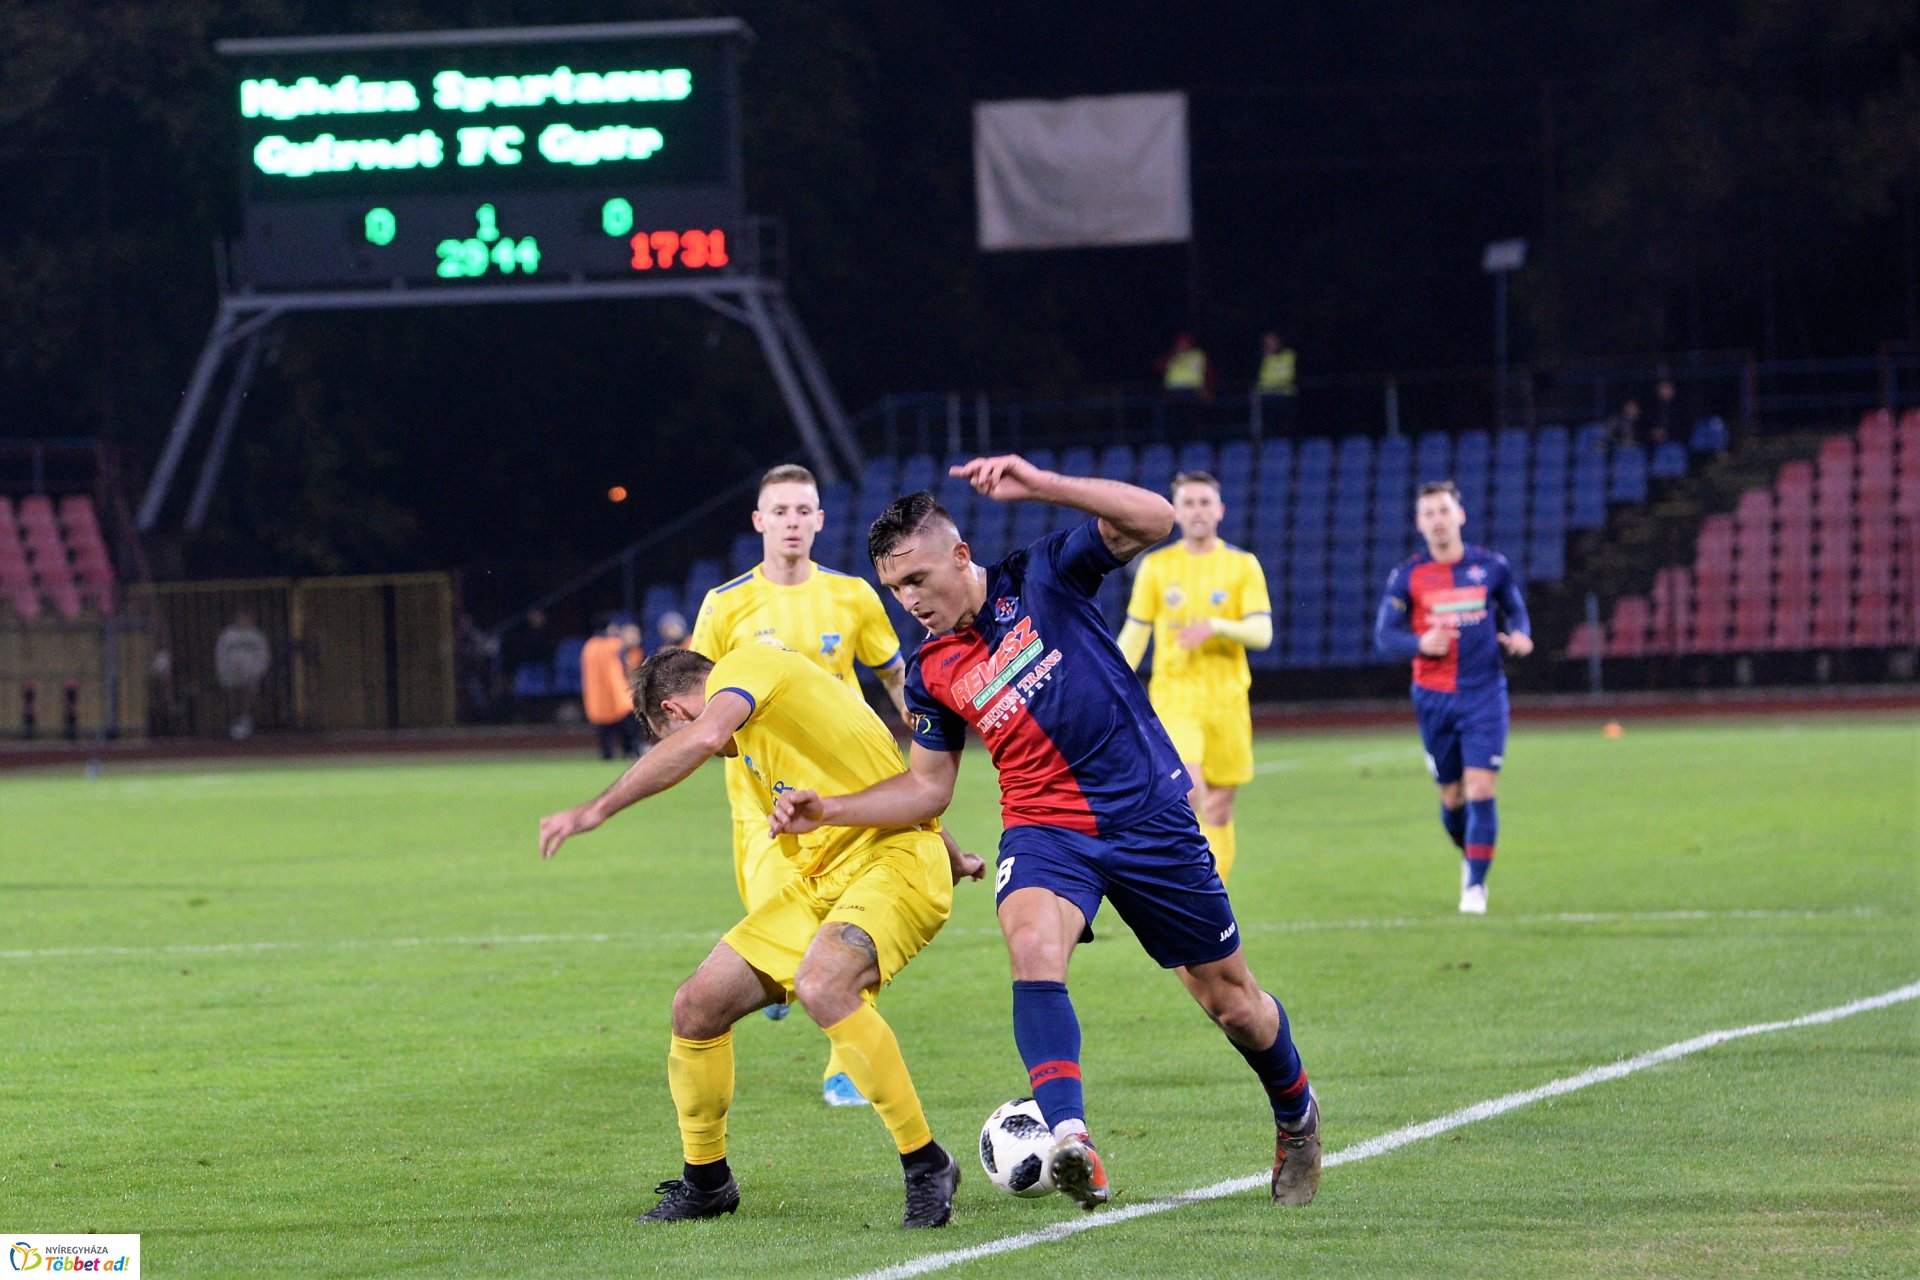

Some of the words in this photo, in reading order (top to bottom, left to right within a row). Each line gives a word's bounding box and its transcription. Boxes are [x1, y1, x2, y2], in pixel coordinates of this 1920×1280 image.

[432, 65, 693, 113] Spartacus
[456, 125, 525, 167] FC
[364, 207, 396, 246] 0
[602, 197, 633, 237] 0
[1016, 648, 1063, 693] TRANS
